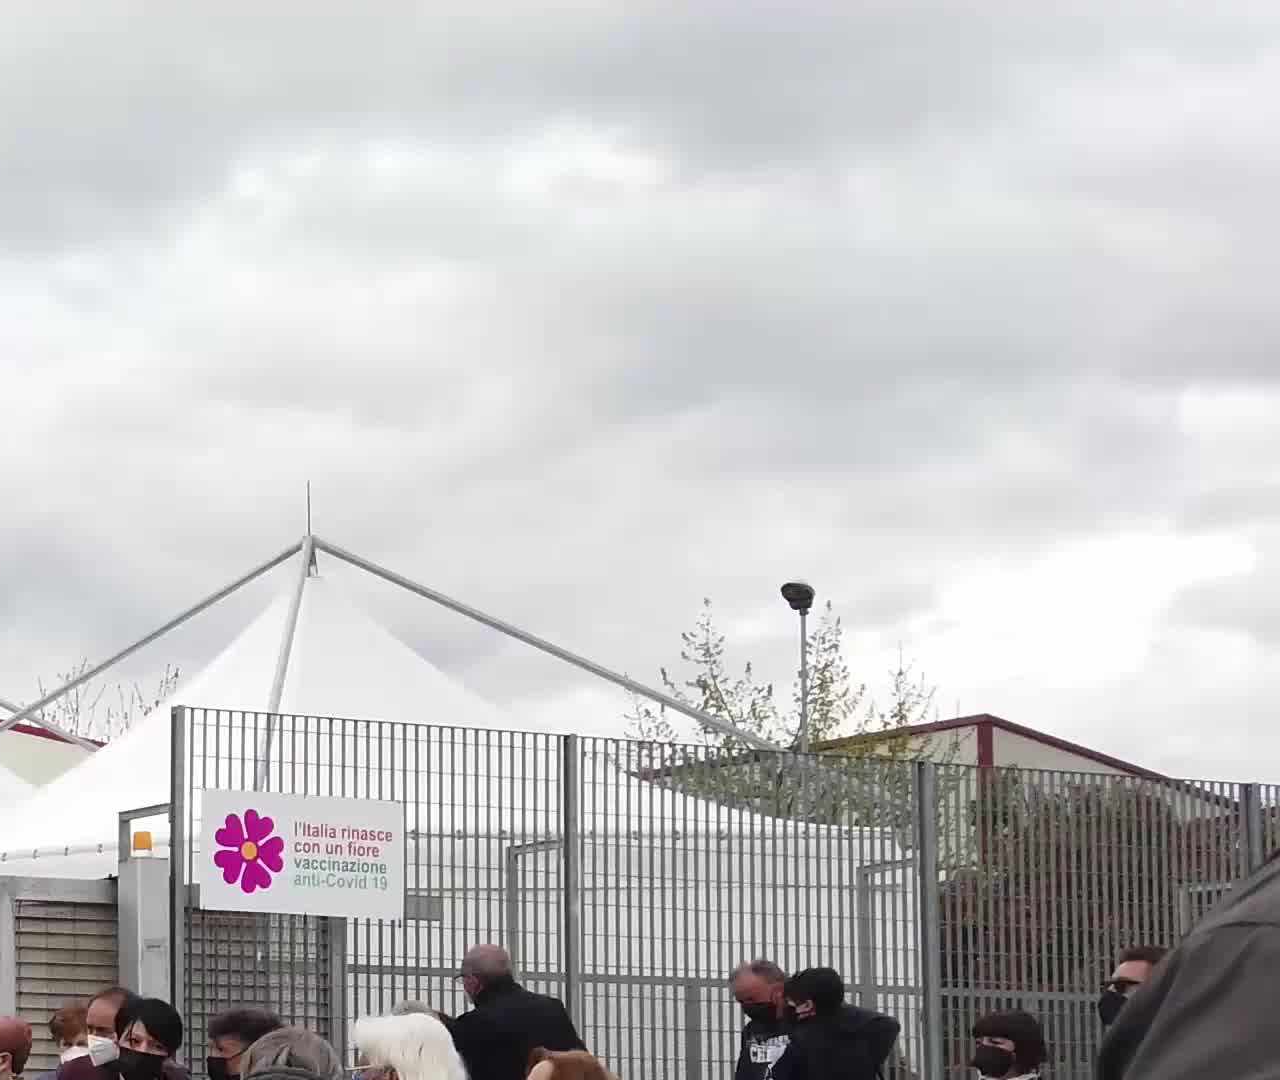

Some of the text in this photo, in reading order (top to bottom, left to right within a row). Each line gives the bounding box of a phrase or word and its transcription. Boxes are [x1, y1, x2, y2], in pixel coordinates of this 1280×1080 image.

[341, 826, 393, 842] rinasce
[294, 841, 380, 858] con un fiore
[294, 858, 387, 874] vaccinazione
[294, 873, 388, 890] anti-Covid 19
